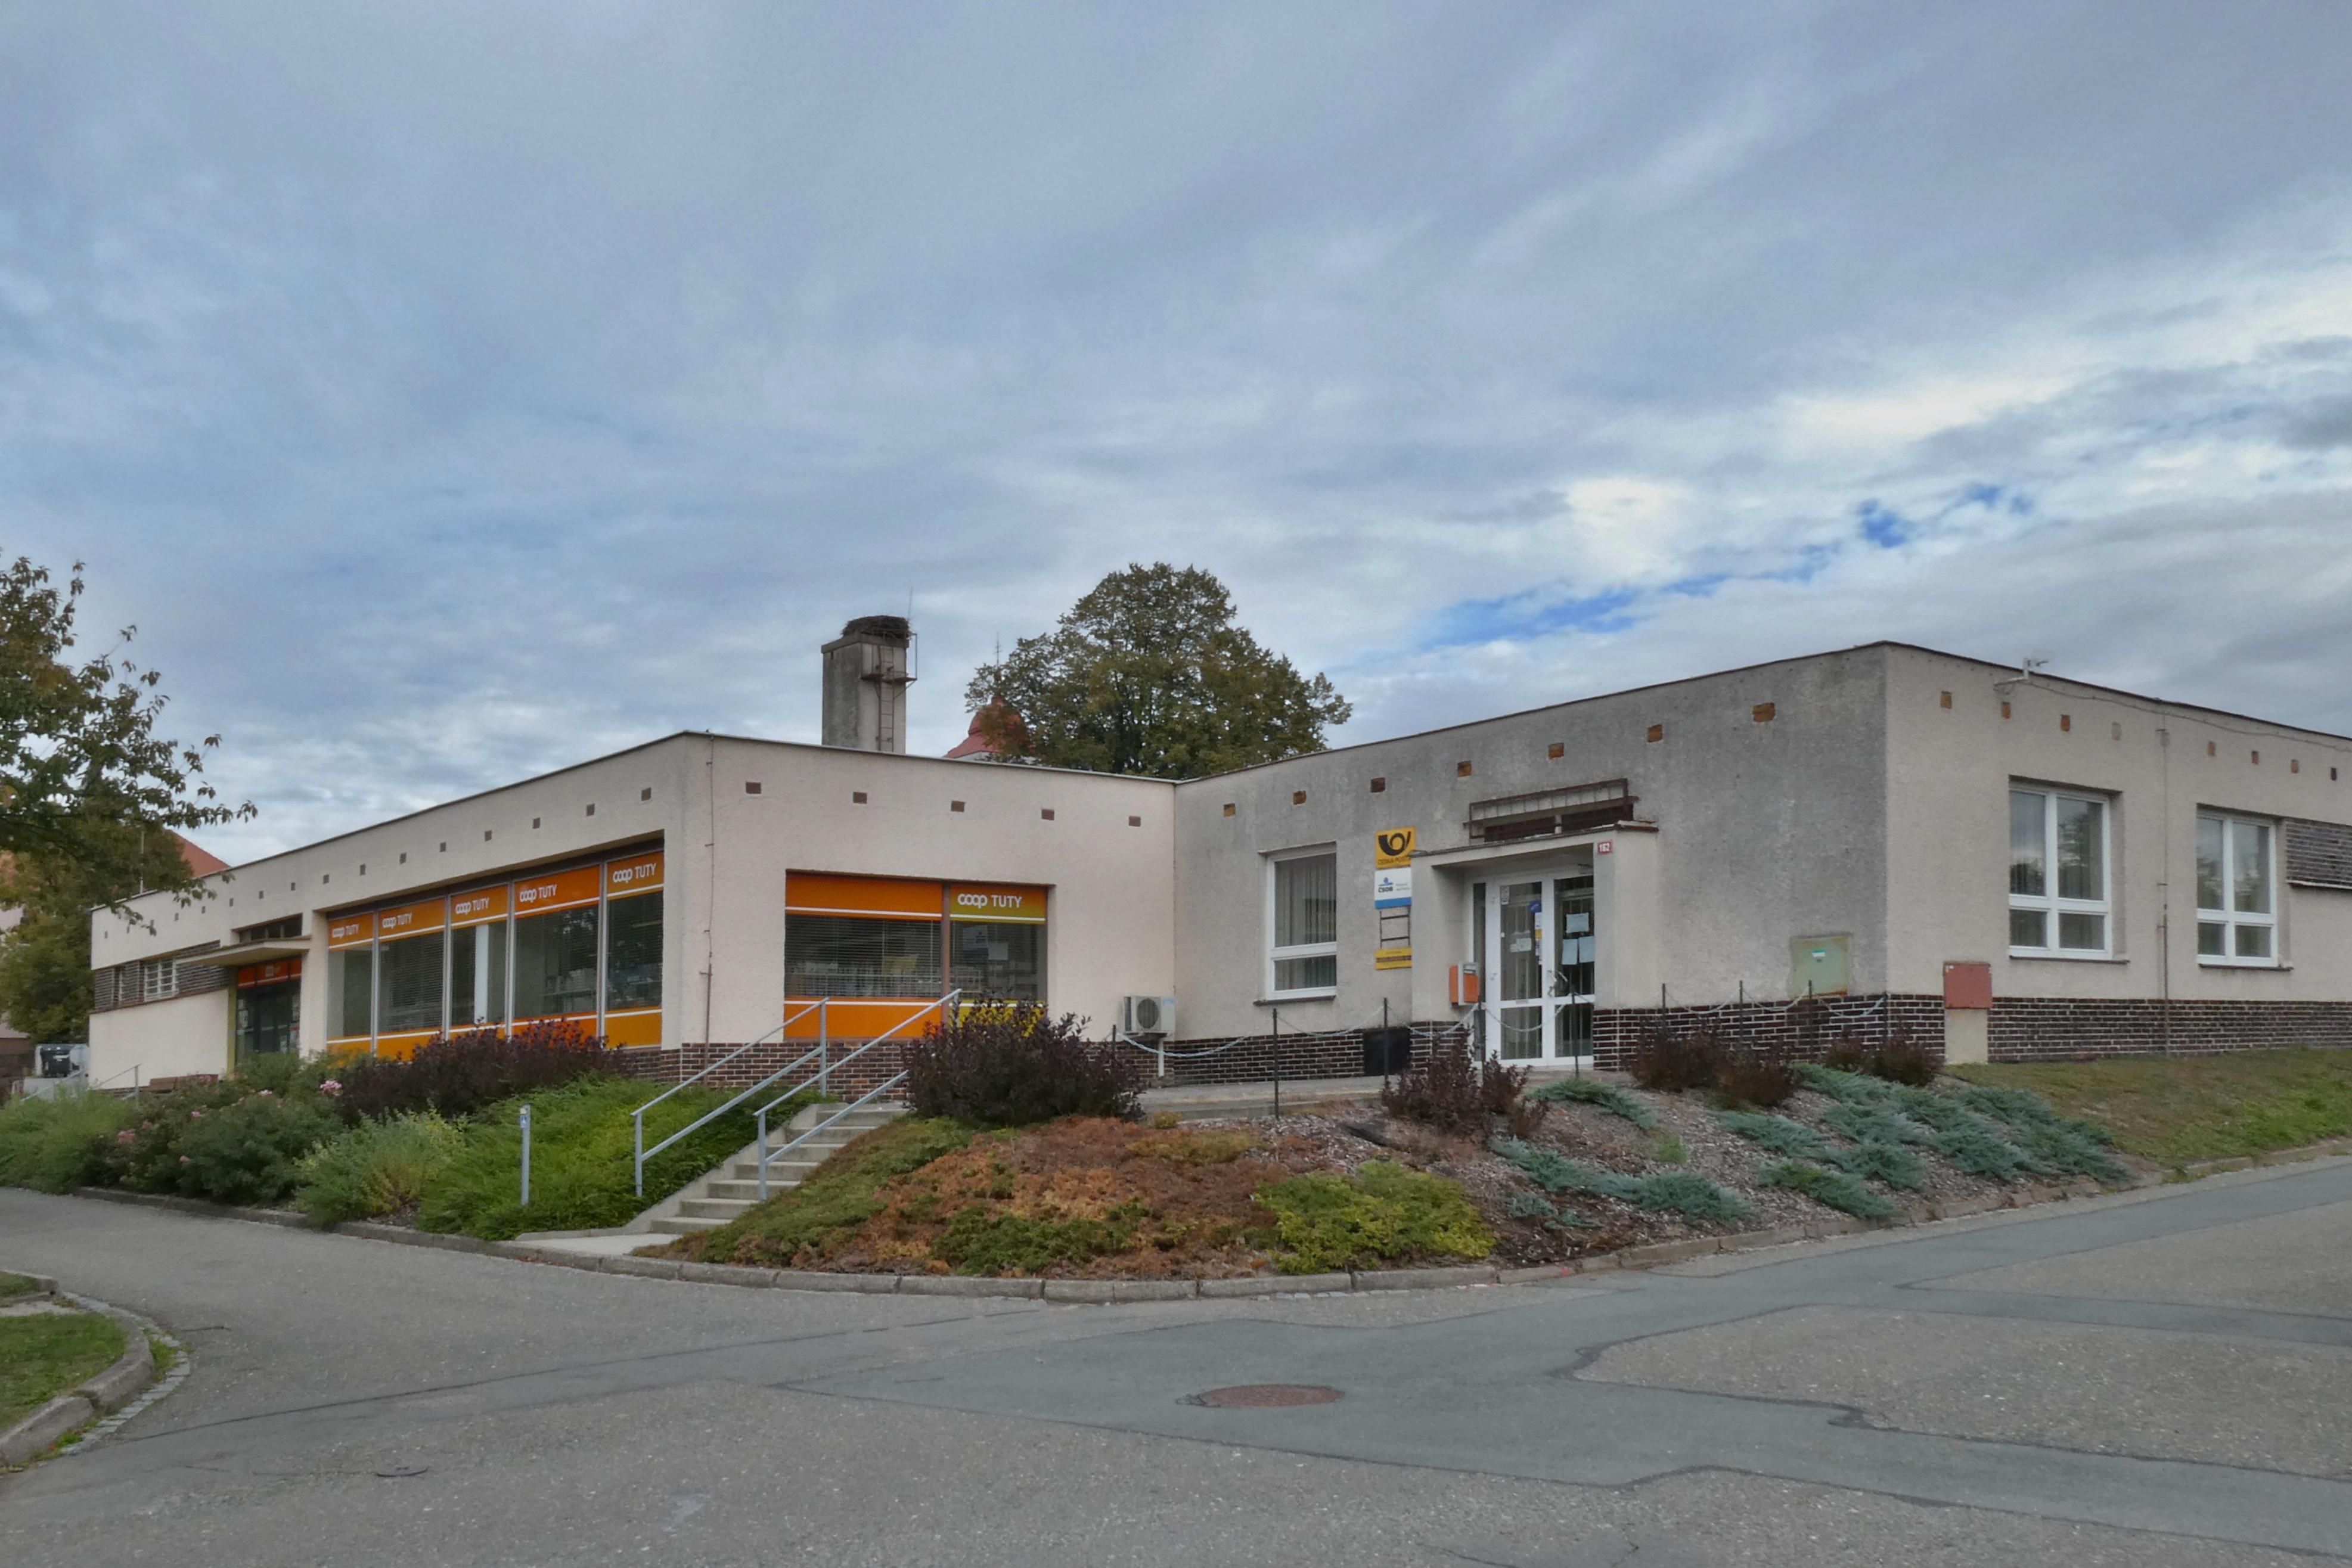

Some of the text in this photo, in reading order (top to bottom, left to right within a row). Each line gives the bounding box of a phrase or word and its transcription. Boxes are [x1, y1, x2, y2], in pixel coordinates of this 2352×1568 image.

[635, 862, 657, 878] TUTY
[538, 884, 557, 899] TUTY
[472, 897, 489, 911] TUTY
[957, 893, 1022, 909] coop TUTY
